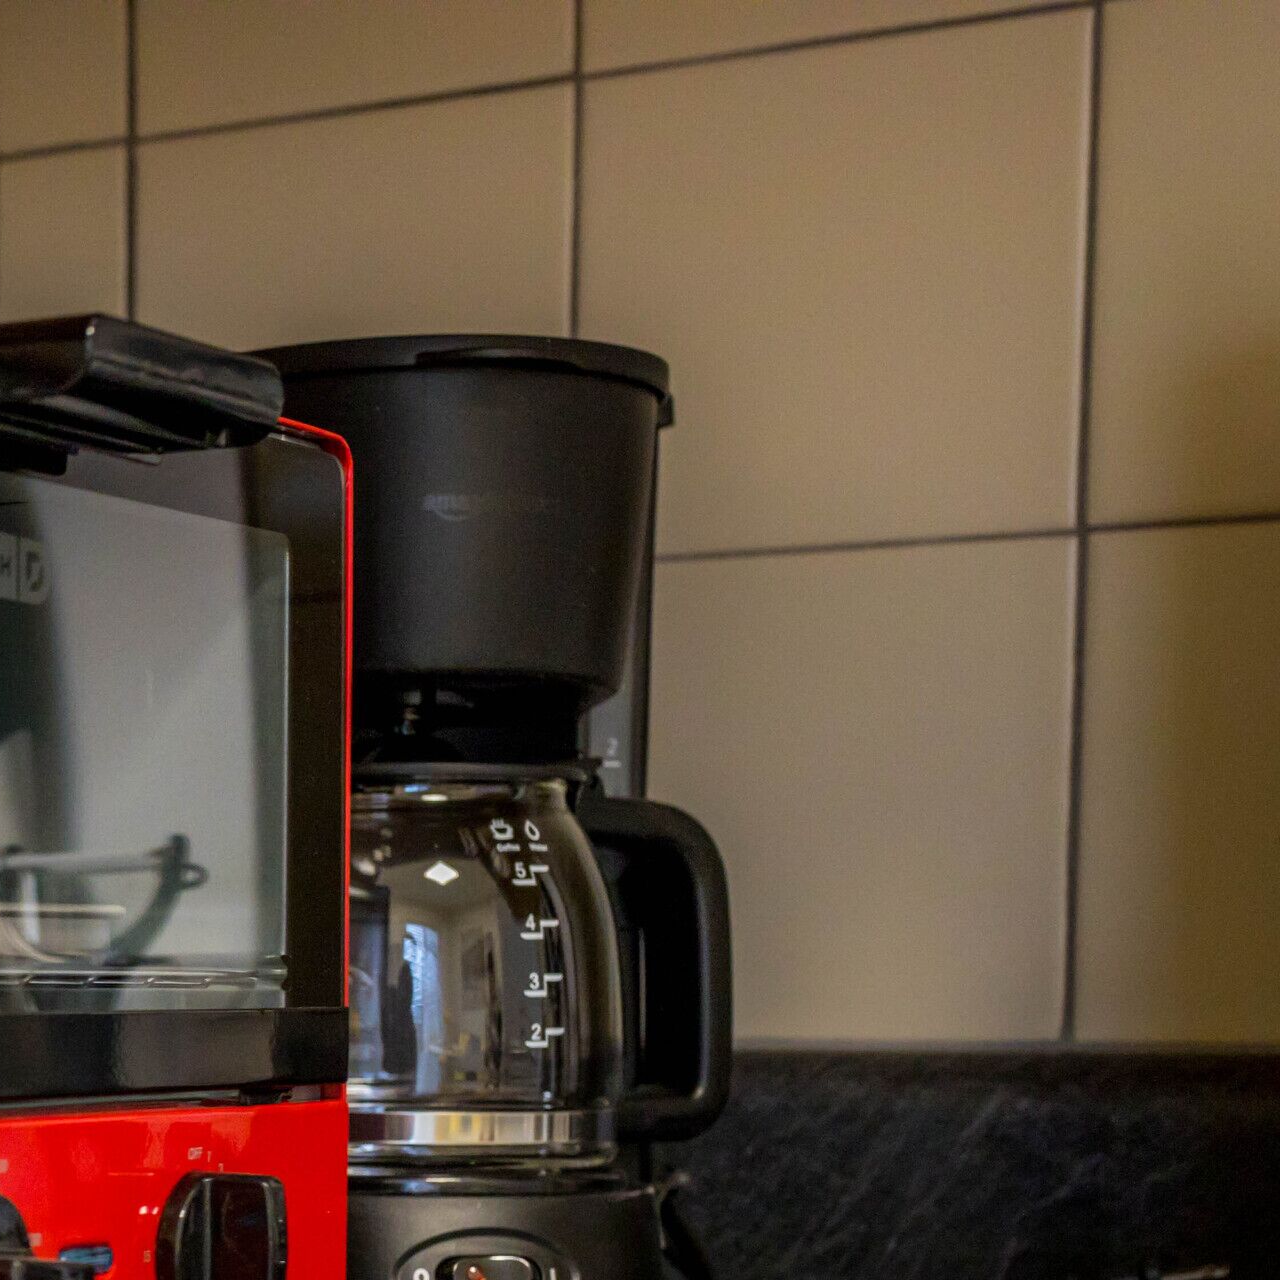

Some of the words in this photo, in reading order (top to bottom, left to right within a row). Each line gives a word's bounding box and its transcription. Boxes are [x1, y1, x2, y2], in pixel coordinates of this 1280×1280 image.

[514, 861, 527, 879] 5
[525, 913, 536, 931] 4
[529, 972, 540, 990] 3
[531, 1023, 542, 1041] 2
